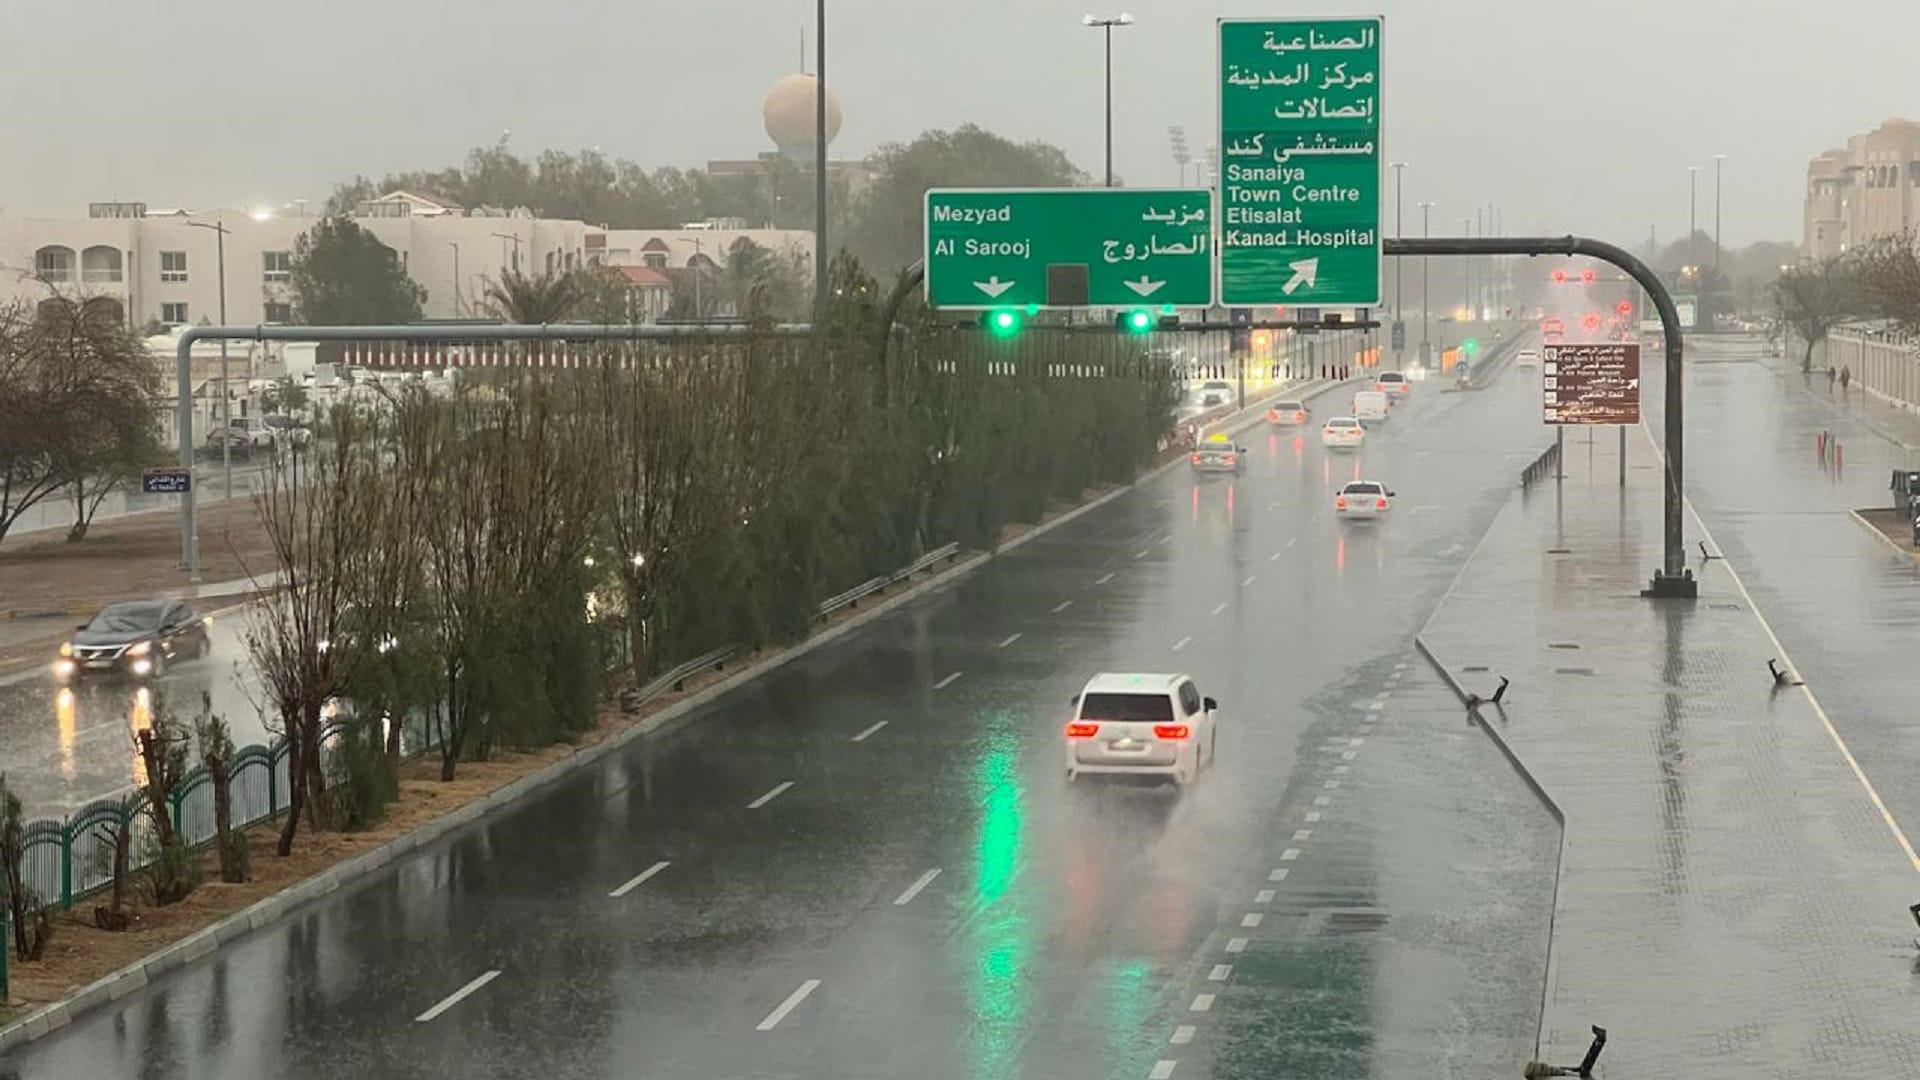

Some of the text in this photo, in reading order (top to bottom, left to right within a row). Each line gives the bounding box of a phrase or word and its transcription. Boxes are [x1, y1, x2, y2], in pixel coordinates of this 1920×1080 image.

[1263, 29, 1375, 54] الصناعية
[1227, 63, 1374, 89] مركز المدينة
[1274, 97, 1373, 122] إتصالات
[1226, 134, 1264, 155] كند
[1227, 165, 1305, 184] Sanaiya
[1227, 186, 1360, 202] Town Centre
[933, 206, 1010, 224] Mezyad
[1142, 206, 1205, 225] مزيد
[1227, 208, 1302, 223] Etisalat
[935, 239, 1030, 258] Al Sarooj
[1103, 235, 1206, 262] الصاروج
[1225, 230, 1374, 248] Kanad Hospital
